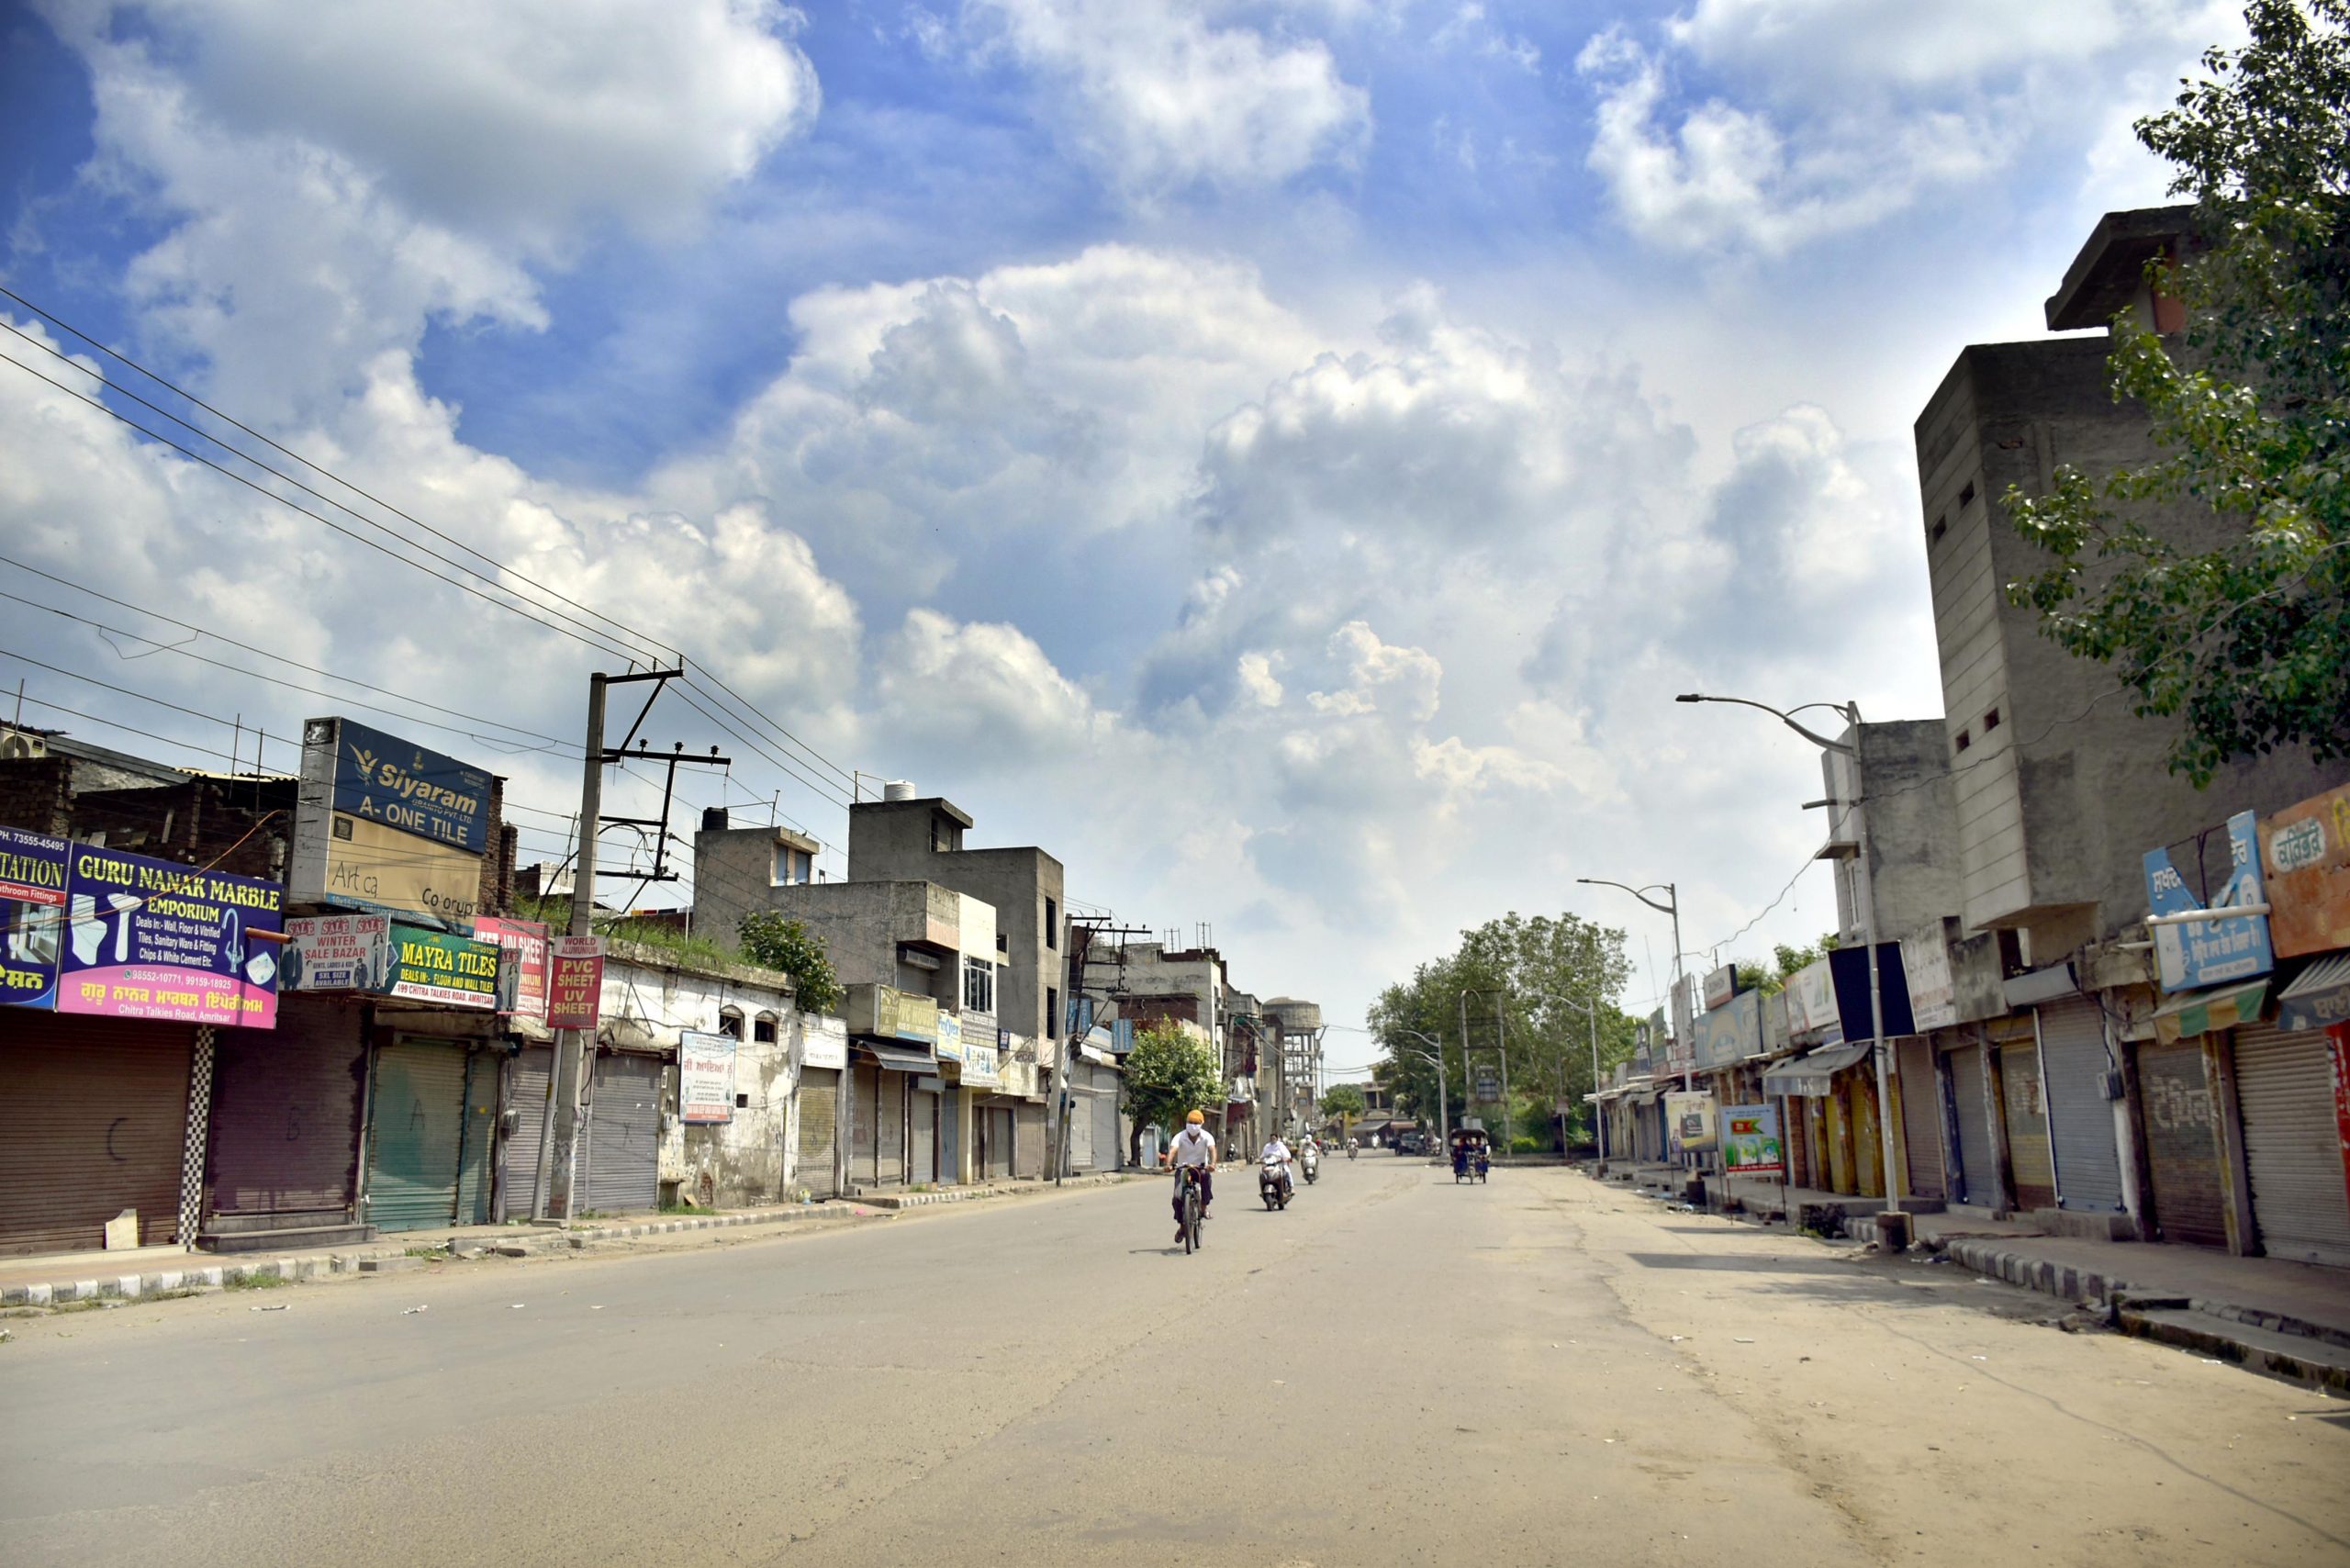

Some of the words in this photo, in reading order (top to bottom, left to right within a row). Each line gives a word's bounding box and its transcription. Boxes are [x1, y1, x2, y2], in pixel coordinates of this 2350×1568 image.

[378, 764, 477, 815] Siyaram
[386, 803, 427, 832] ONE
[431, 817, 468, 846] TILE
[14, 833, 65, 852] 73555-45495
[78, 855, 135, 886] GURU
[139, 867, 206, 899] NANAK
[210, 880, 280, 912] MARBLE
[30, 890, 57, 902] Fittings
[148, 897, 219, 923] EMPORIUM
[136, 915, 152, 928] Deals
[179, 922, 194, 935] Floor
[194, 924, 199, 935] &
[199, 924, 221, 938] Vitrified
[287, 924, 315, 936] SALE
[322, 923, 349, 935] SALE
[356, 920, 385, 933] SALE
[154, 934, 178, 950] Sanitary
[179, 937, 193, 950] Ware
[194, 939, 198, 950] &
[199, 940, 217, 956] Fitting
[318, 936, 356, 946] WINTER
[519, 936, 544, 965] SHEET
[565, 937, 597, 946] WORLD
[140, 947, 156, 962] Chips
[157, 949, 162, 961] &
[162, 950, 179, 964] White
[180, 953, 202, 967] Cement
[305, 948, 330, 959] SALE
[333, 947, 366, 958] BAZAR
[400, 942, 453, 970] MAYRA
[458, 952, 497, 978] TILES
[562, 960, 593, 973] PVC
[400, 969, 419, 982] DEALS
[433, 973, 451, 986] FLOOR
[453, 977, 464, 988] AND
[464, 979, 478, 991] WALL
[479, 980, 494, 993] TILES
[557, 975, 596, 987] SHEET
[81, 983, 106, 1006] ਗੁਰੂ
[113, 985, 150, 1003] ਨਾਨਕ
[397, 984, 408, 992] 199
[409, 985, 428, 996] CHITRA
[431, 988, 451, 1000] TALKIES
[468, 994, 493, 1005] AMRITSAR
[565, 991, 586, 1002] UV
[118, 1003, 144, 1016] Chitra
[146, 1006, 173, 1018] Talkies
[199, 1011, 230, 1023] Amritsar
[553, 1002, 594, 1014] SHEET
